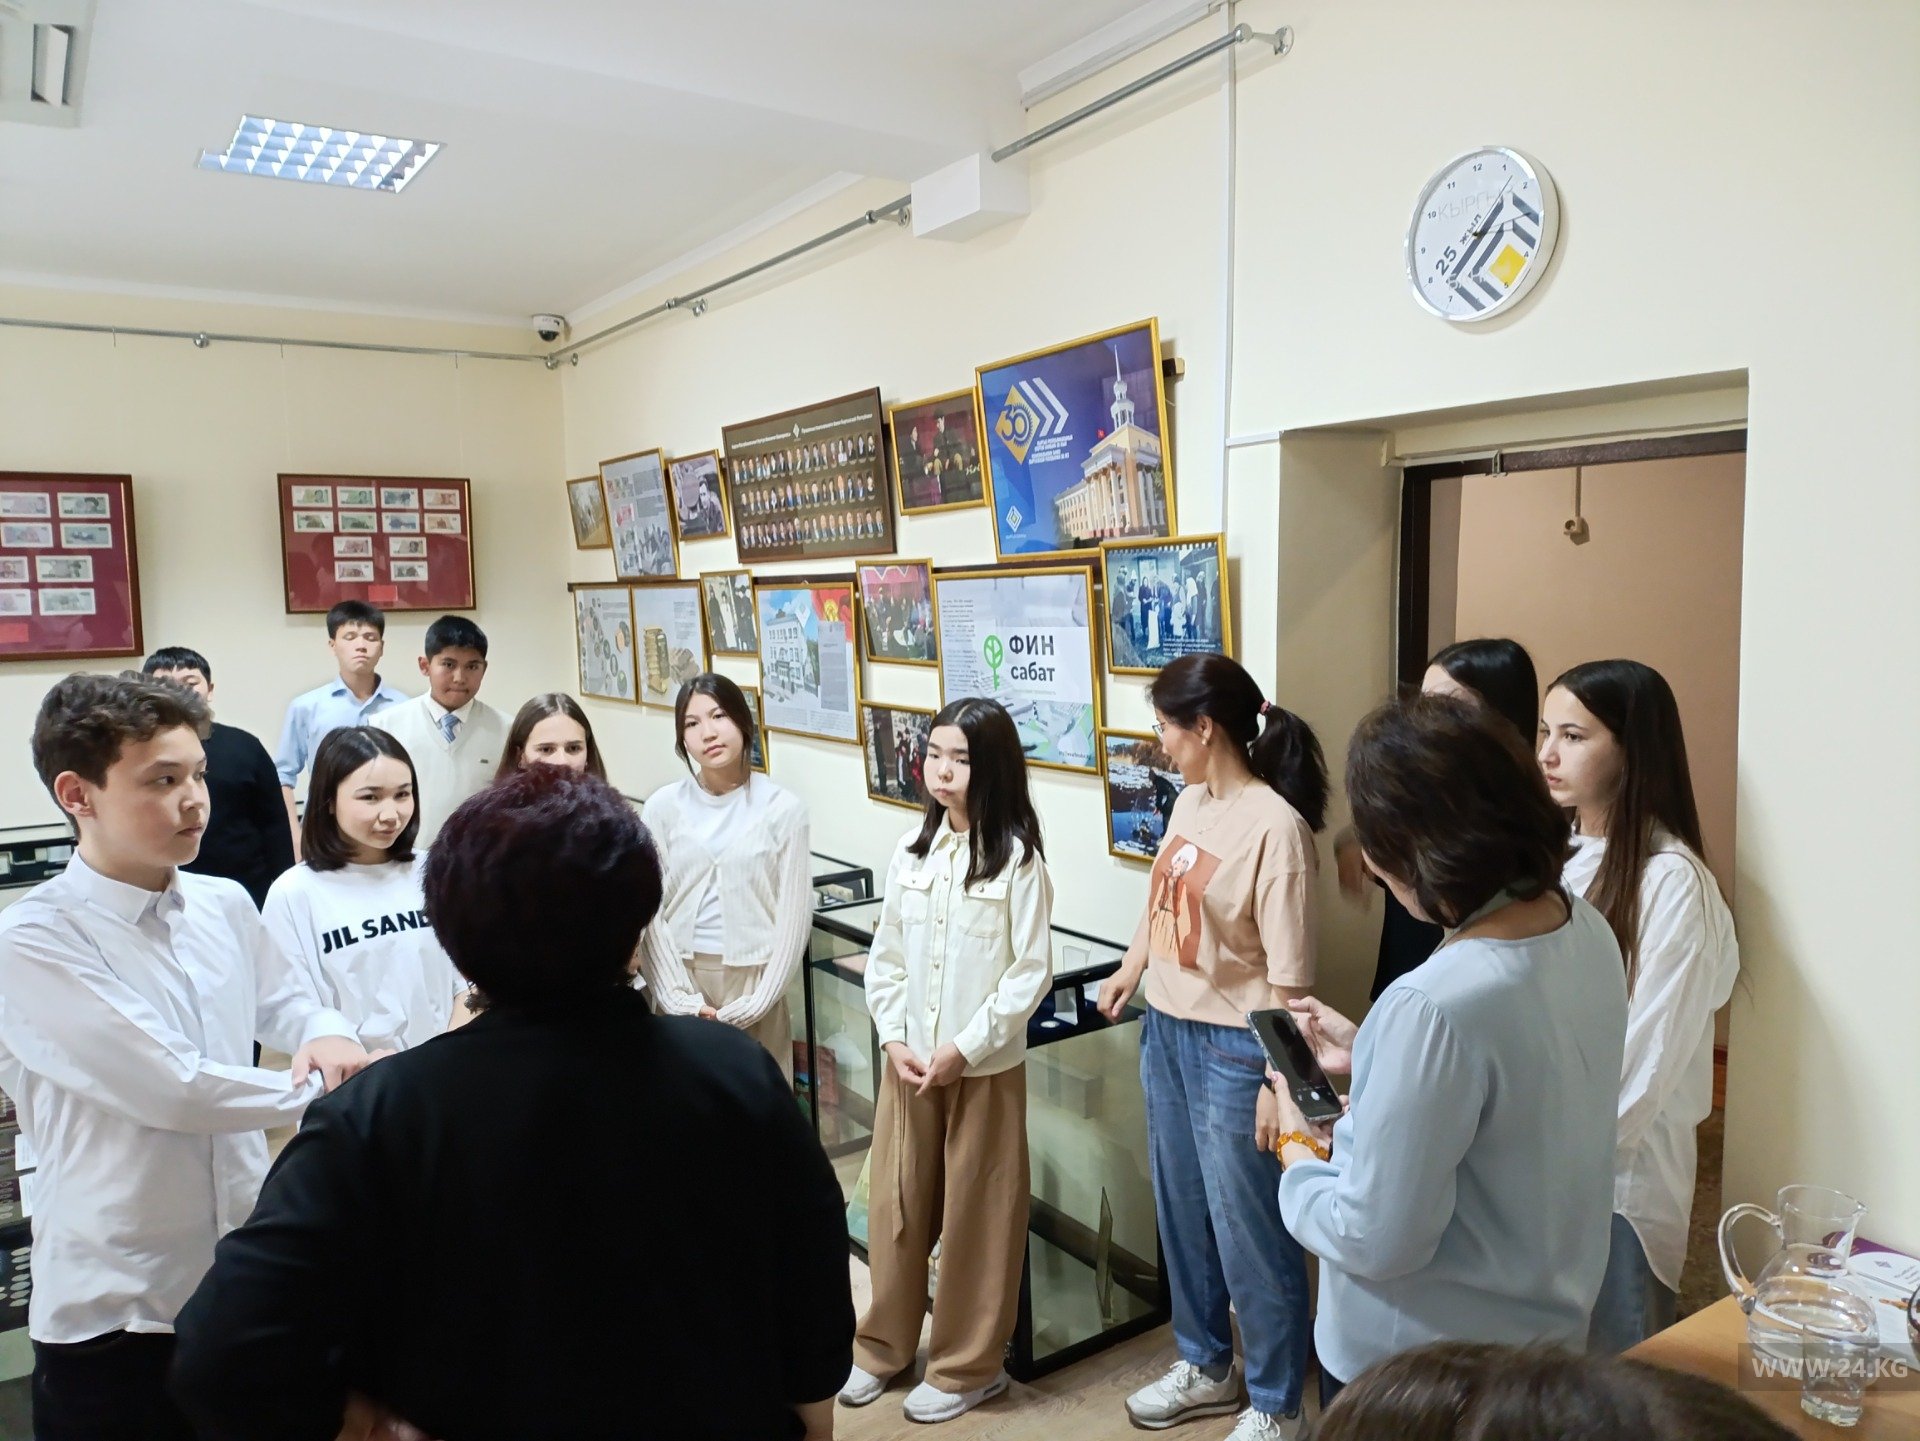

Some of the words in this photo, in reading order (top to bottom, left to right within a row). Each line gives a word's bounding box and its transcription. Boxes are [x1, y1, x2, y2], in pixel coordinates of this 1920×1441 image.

[1472, 163, 1483, 172] 12
[1447, 181, 1456, 189] 11
[1427, 211, 1437, 220] 10
[1435, 246, 1457, 276] 25
[1008, 634, 1055, 656] ФИН
[1010, 661, 1056, 682] сабат
[322, 926, 359, 954] JIL
